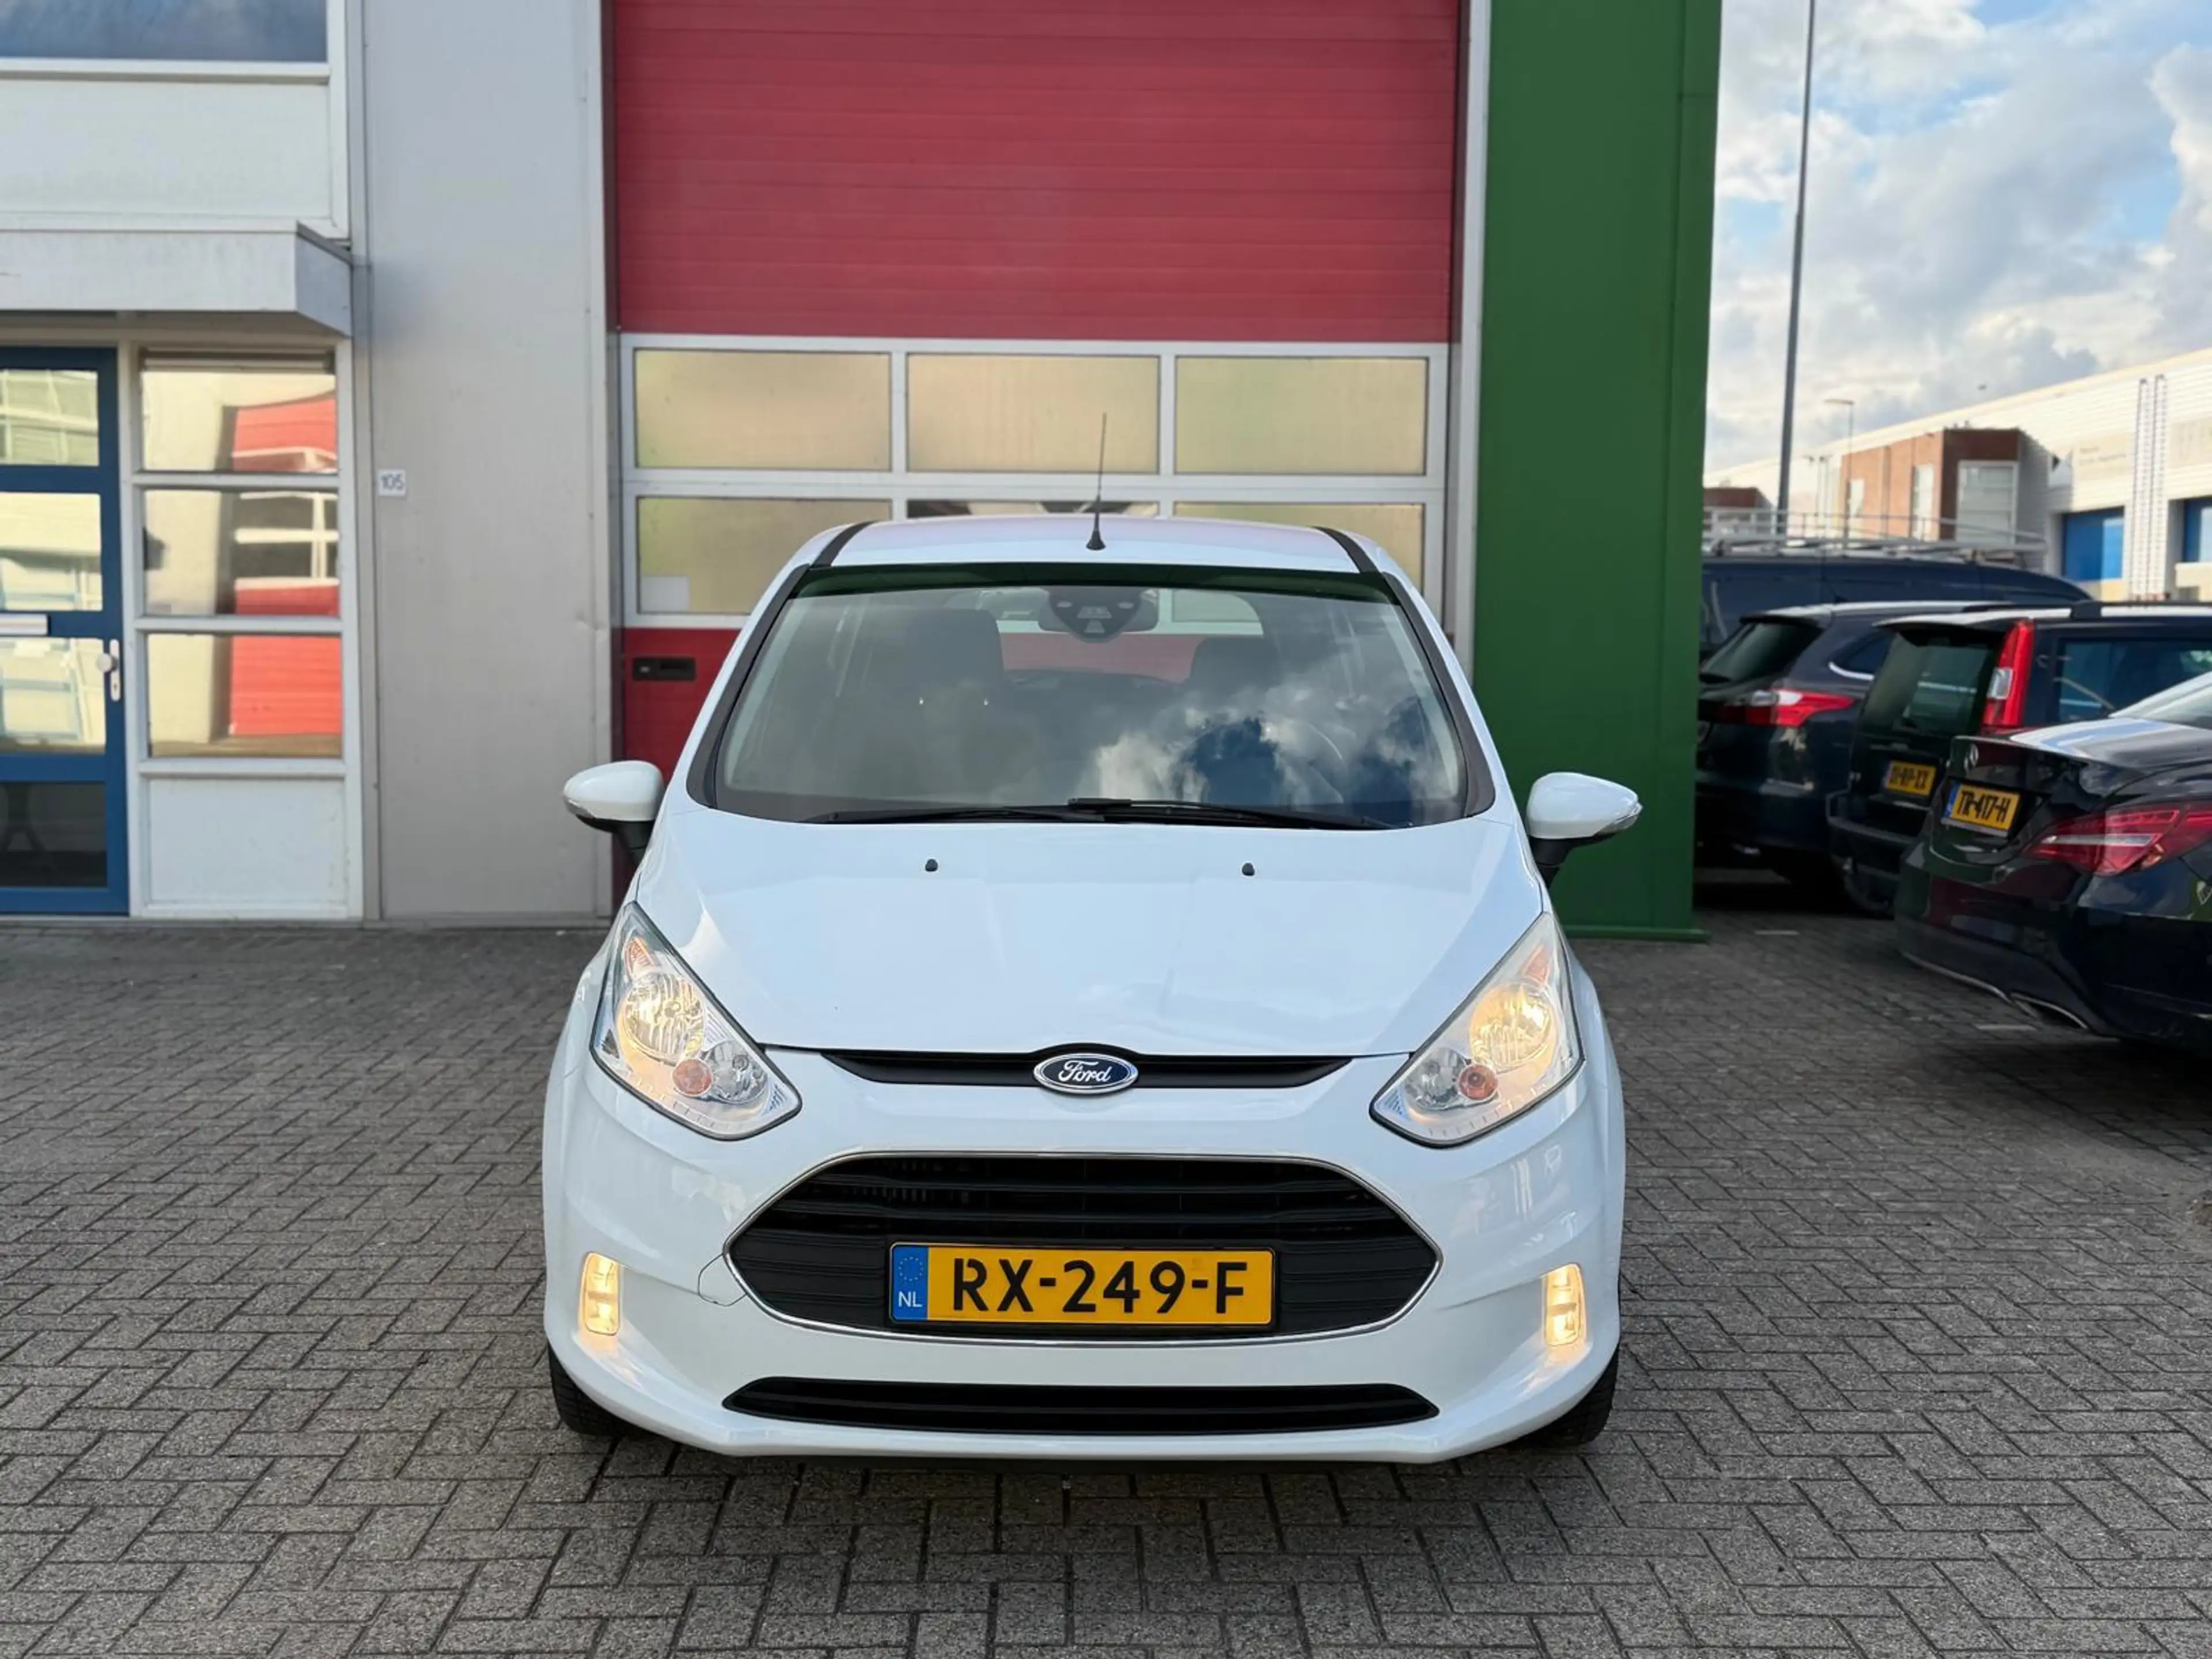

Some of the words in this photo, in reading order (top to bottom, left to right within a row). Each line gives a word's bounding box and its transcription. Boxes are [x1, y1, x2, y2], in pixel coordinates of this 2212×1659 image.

[380, 474, 403, 491] 105
[1058, 1060, 1112, 1082] Ford
[898, 1291, 923, 1308] NL
[953, 1258, 1247, 1314] RX-249-F
